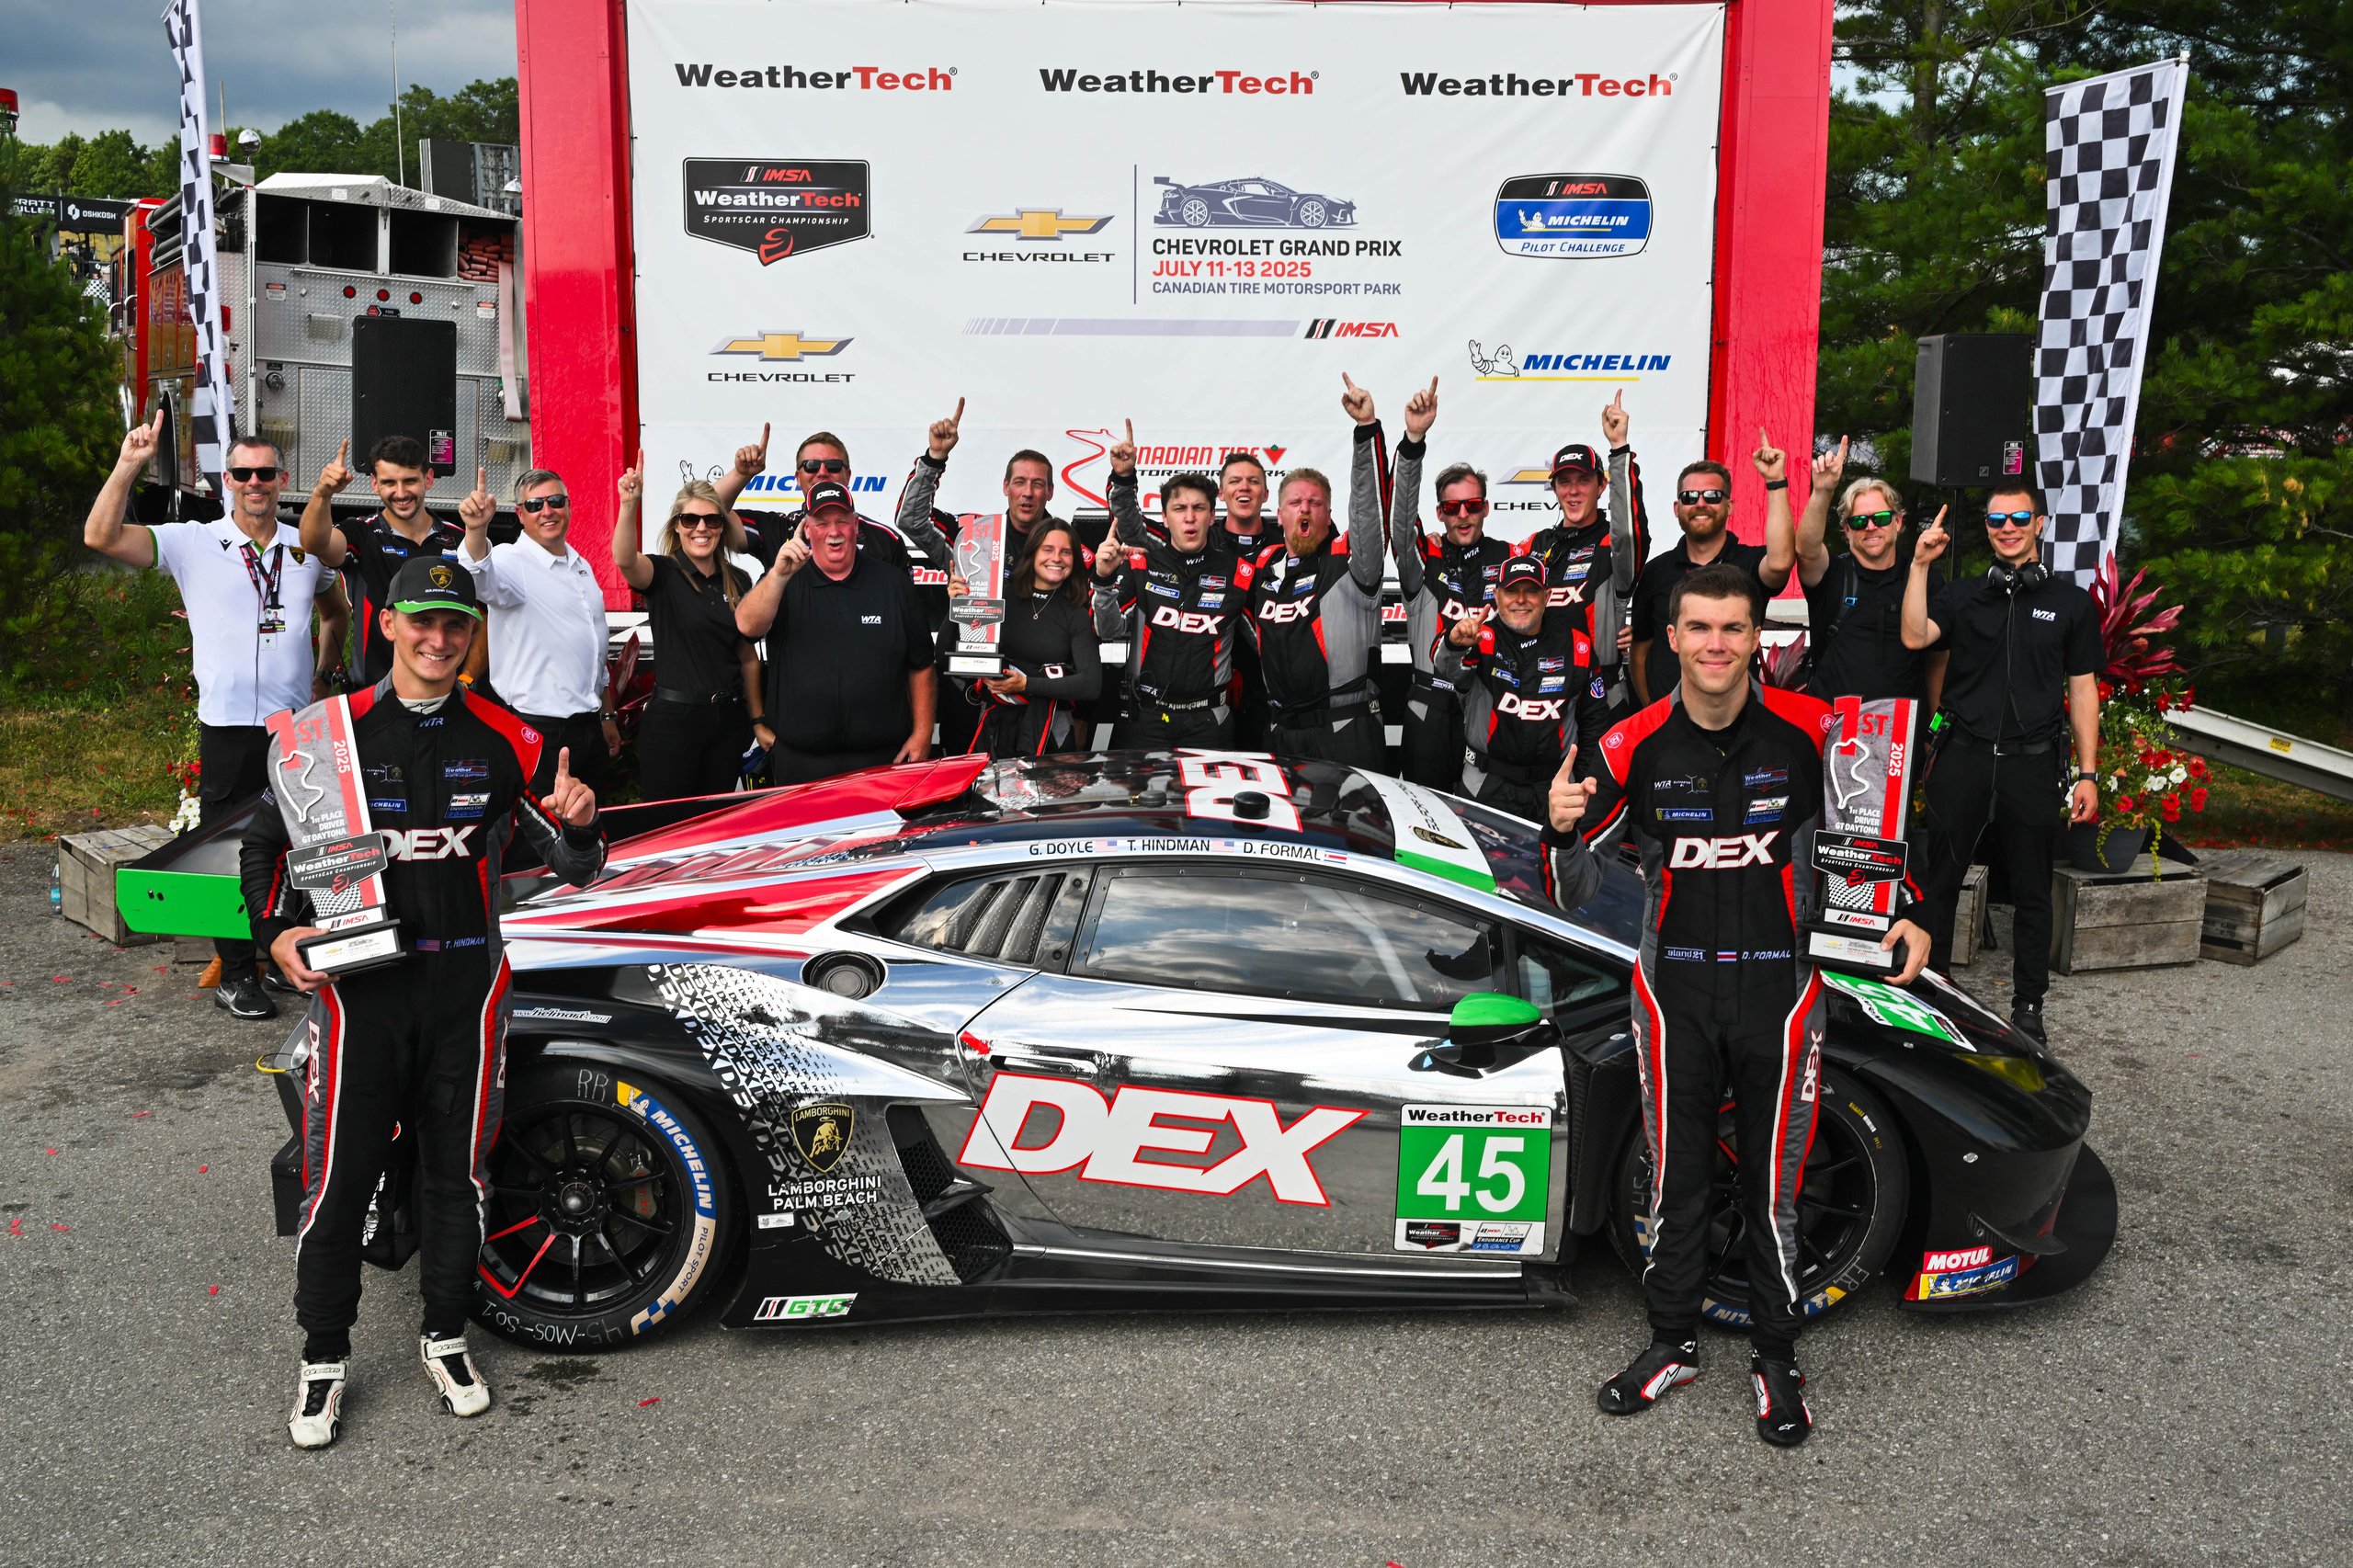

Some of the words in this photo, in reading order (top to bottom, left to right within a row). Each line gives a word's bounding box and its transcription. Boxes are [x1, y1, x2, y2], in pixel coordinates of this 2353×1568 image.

[762, 169, 812, 182] IMSA
[1563, 183, 1608, 195] IMSA
[694, 190, 860, 207] WeatherTech
[83, 210, 116, 220] OSHKOSH
[1548, 215, 1629, 226] MICHELIN
[1153, 238, 1274, 256] CHEVROLET
[1279, 240, 1351, 256] GRAND
[1356, 240, 1402, 256] PRIX
[962, 252, 1115, 263] CHEVROLET
[1153, 260, 1202, 278] JULY
[1206, 260, 1256, 278] 11-13
[1260, 261, 1312, 278] 2025
[1153, 281, 1226, 294] CANADIAN
[1229, 282, 1260, 294] TIRE
[1263, 282, 1360, 295] MOTORSPORT
[1364, 283, 1402, 295] PARK
[1335, 323, 1400, 338] IMSA
[1523, 355, 1671, 370] MICHELIN
[708, 372, 856, 383] CHEVROLET
[1559, 452, 1584, 462] DEX
[816, 490, 840, 500] DEX
[992, 540, 1000, 562] 2025
[1510, 563, 1535, 573] DEX
[1546, 581, 1588, 608] EX
[1259, 595, 1315, 623] DEX
[2032, 608, 2056, 621] WTR
[1152, 606, 1225, 634] DEX
[1497, 692, 1566, 720] DEX
[419, 717, 444, 727] WTR
[334, 740, 351, 774] 2025
[1889, 742, 1904, 777] 2025
[321, 811, 344, 822] PLACE
[1859, 807, 1881, 818] PLACE
[319, 819, 345, 831] DRIVER
[1854, 815, 1880, 826] DRIVER
[301, 835, 312, 844] GT
[312, 828, 347, 843] DAYTONA
[1836, 822, 1845, 831] GT
[1845, 823, 1879, 835] DAYTONA
[328, 843, 353, 853] IMSA
[1029, 845, 1042, 856] G.
[1046, 841, 1094, 855] DOYLE
[1127, 840, 1139, 851] T.
[1142, 839, 1211, 852] HINDMAN
[1243, 842, 1257, 855] D.
[1260, 843, 1321, 861] FORMAL
[1669, 829, 1781, 869] DEX
[1853, 839, 1879, 849] IMSA
[294, 847, 381, 873] WeatherTech
[1817, 845, 1903, 865] WeatherTech
[343, 915, 369, 926] IMSA
[1849, 916, 1876, 926] IMSA
[453, 936, 486, 949] HINDMAN
[1742, 951, 1751, 960] D.
[1753, 949, 1791, 960] FORMAL
[308, 1018, 320, 1106] DEX
[1801, 1029, 1823, 1102] DEX
[578, 1069, 608, 1102] RR
[795, 1108, 850, 1123] LAMBORGHINI
[1408, 1110, 1543, 1123] WeatherTech
[956, 1071, 1373, 1208] DEX
[651, 1109, 712, 1210] MICHELIN
[1416, 1134, 1526, 1213] 45
[768, 1176, 881, 1197] LAMBORGHINI
[773, 1195, 818, 1210] PALM
[823, 1191, 877, 1207] BEACH
[694, 1227, 709, 1259] PILOT
[1927, 1247, 1989, 1270] MOTUL
[677, 1259, 699, 1292] SPORT
